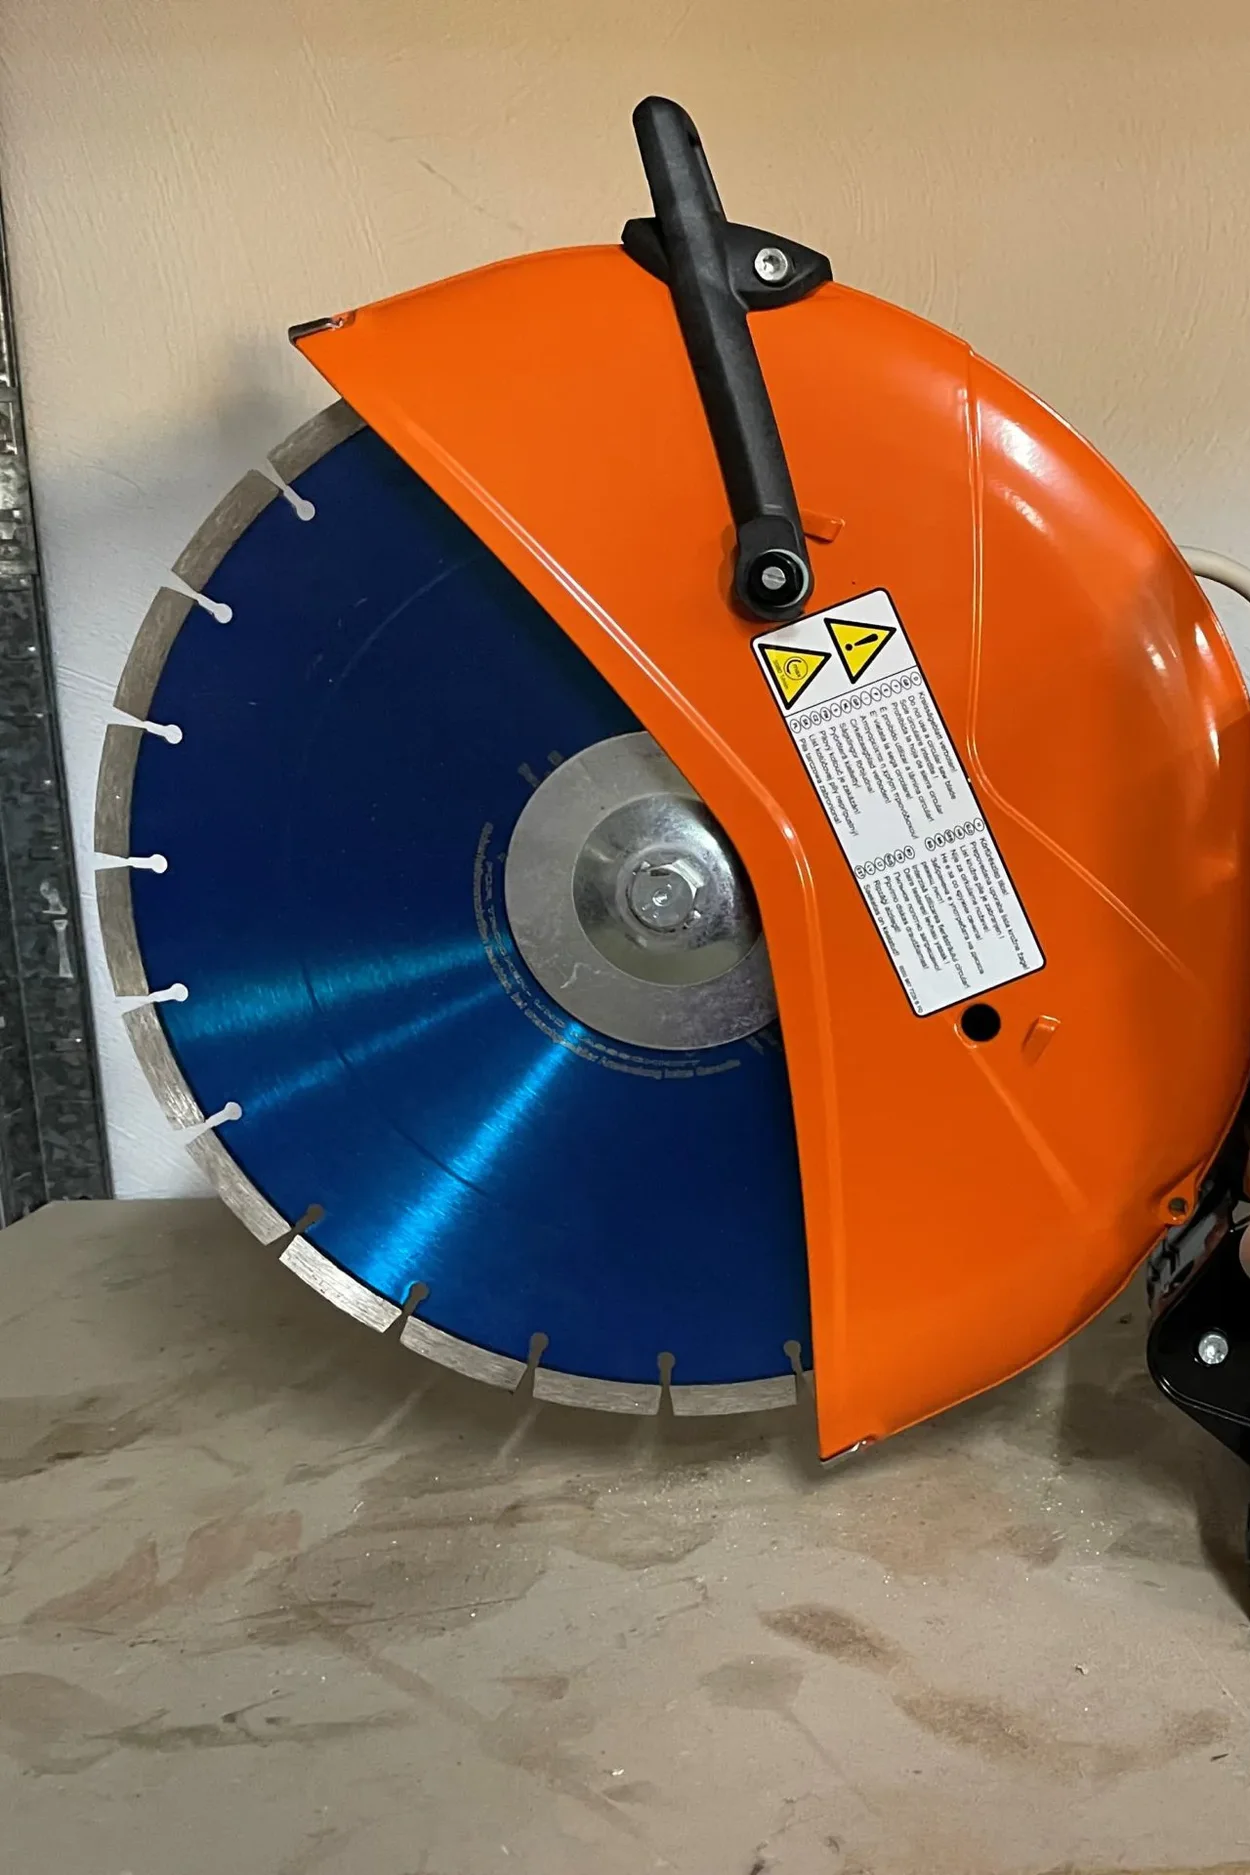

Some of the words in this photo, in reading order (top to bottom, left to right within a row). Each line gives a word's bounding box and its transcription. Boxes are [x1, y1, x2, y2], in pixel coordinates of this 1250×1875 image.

[873, 718, 887, 742] vietata
[886, 750, 898, 768] sega
[881, 713, 898, 742] proibido
[899, 698, 910, 715] Scie
[906, 715, 923, 747] circulaire
[891, 701, 908, 735] Prohibida
[909, 742, 919, 759] hoja
[919, 769, 932, 790] sierra
[928, 790, 943, 814] circular
[926, 739, 942, 764] circular
[944, 780, 956, 800] blade
[959, 844, 969, 858] List
